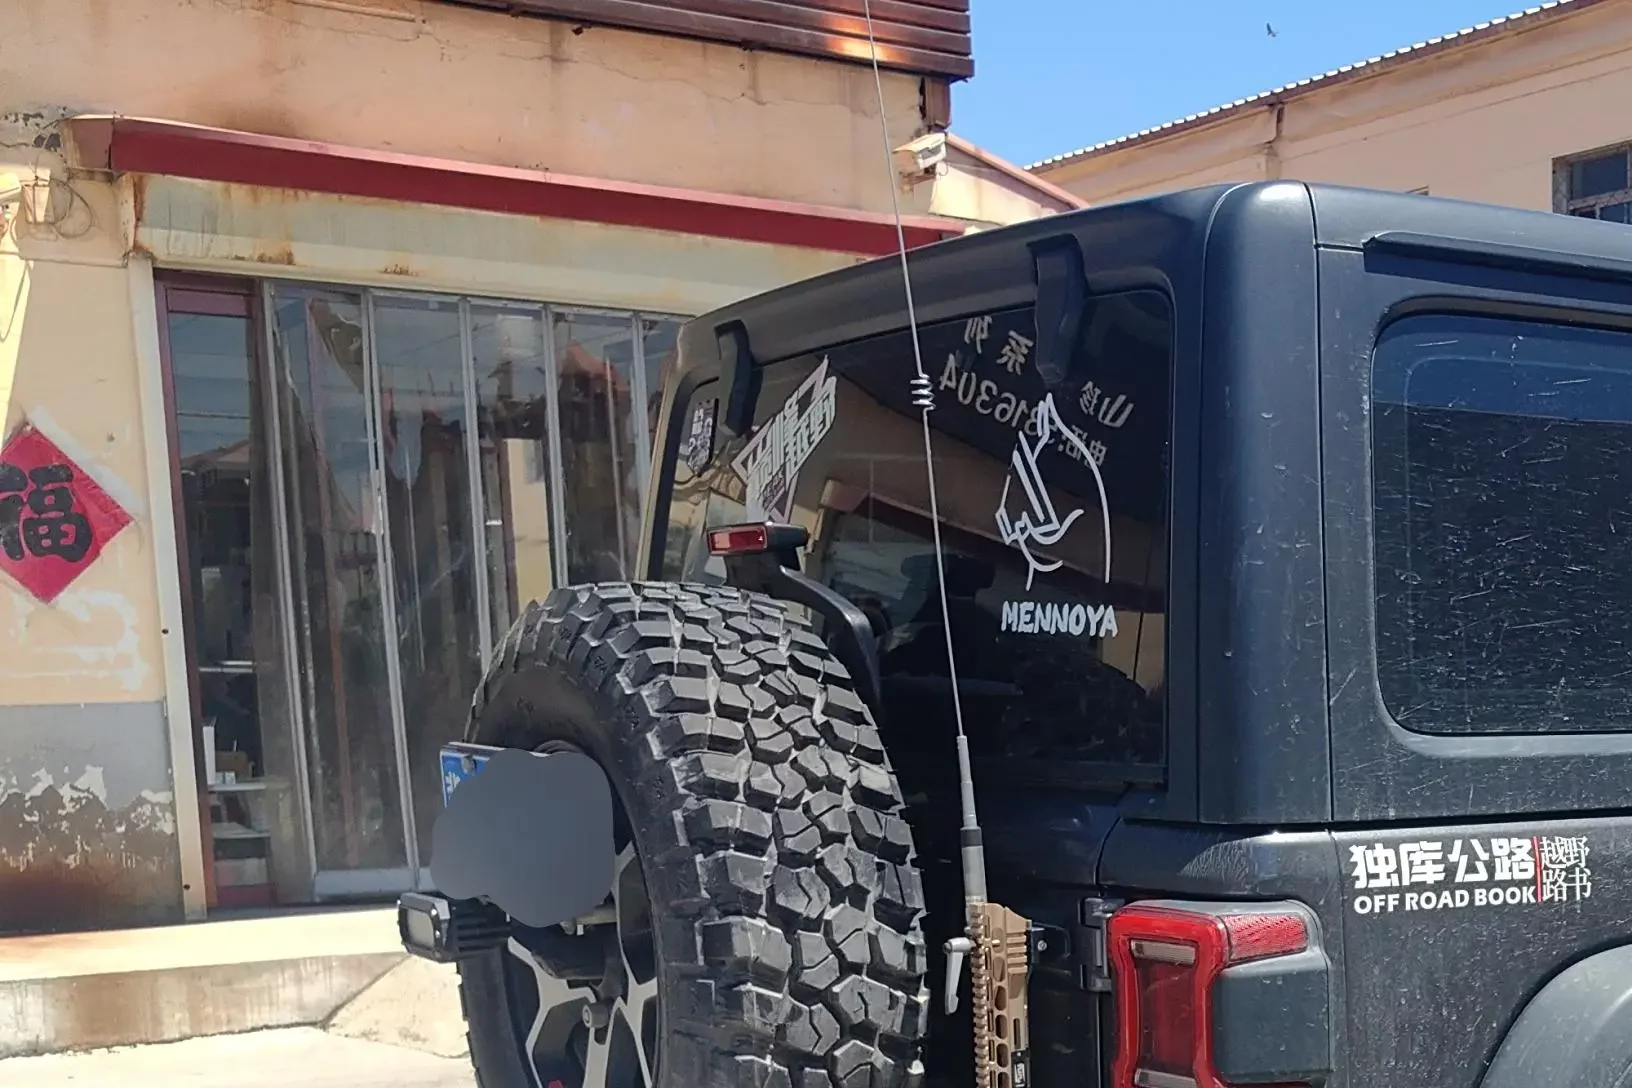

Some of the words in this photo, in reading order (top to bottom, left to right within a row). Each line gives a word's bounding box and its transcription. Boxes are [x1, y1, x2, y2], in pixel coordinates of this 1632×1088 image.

[0, 463, 93, 563] 福
[1000, 600, 1119, 638] MENNOYA
[1348, 837, 1536, 889] 独库公路
[1539, 835, 1591, 869] 越野
[1353, 892, 1400, 914] OFF
[1404, 888, 1470, 911] ROAD
[1474, 885, 1538, 906] BOOK
[1541, 866, 1592, 903] 路书
